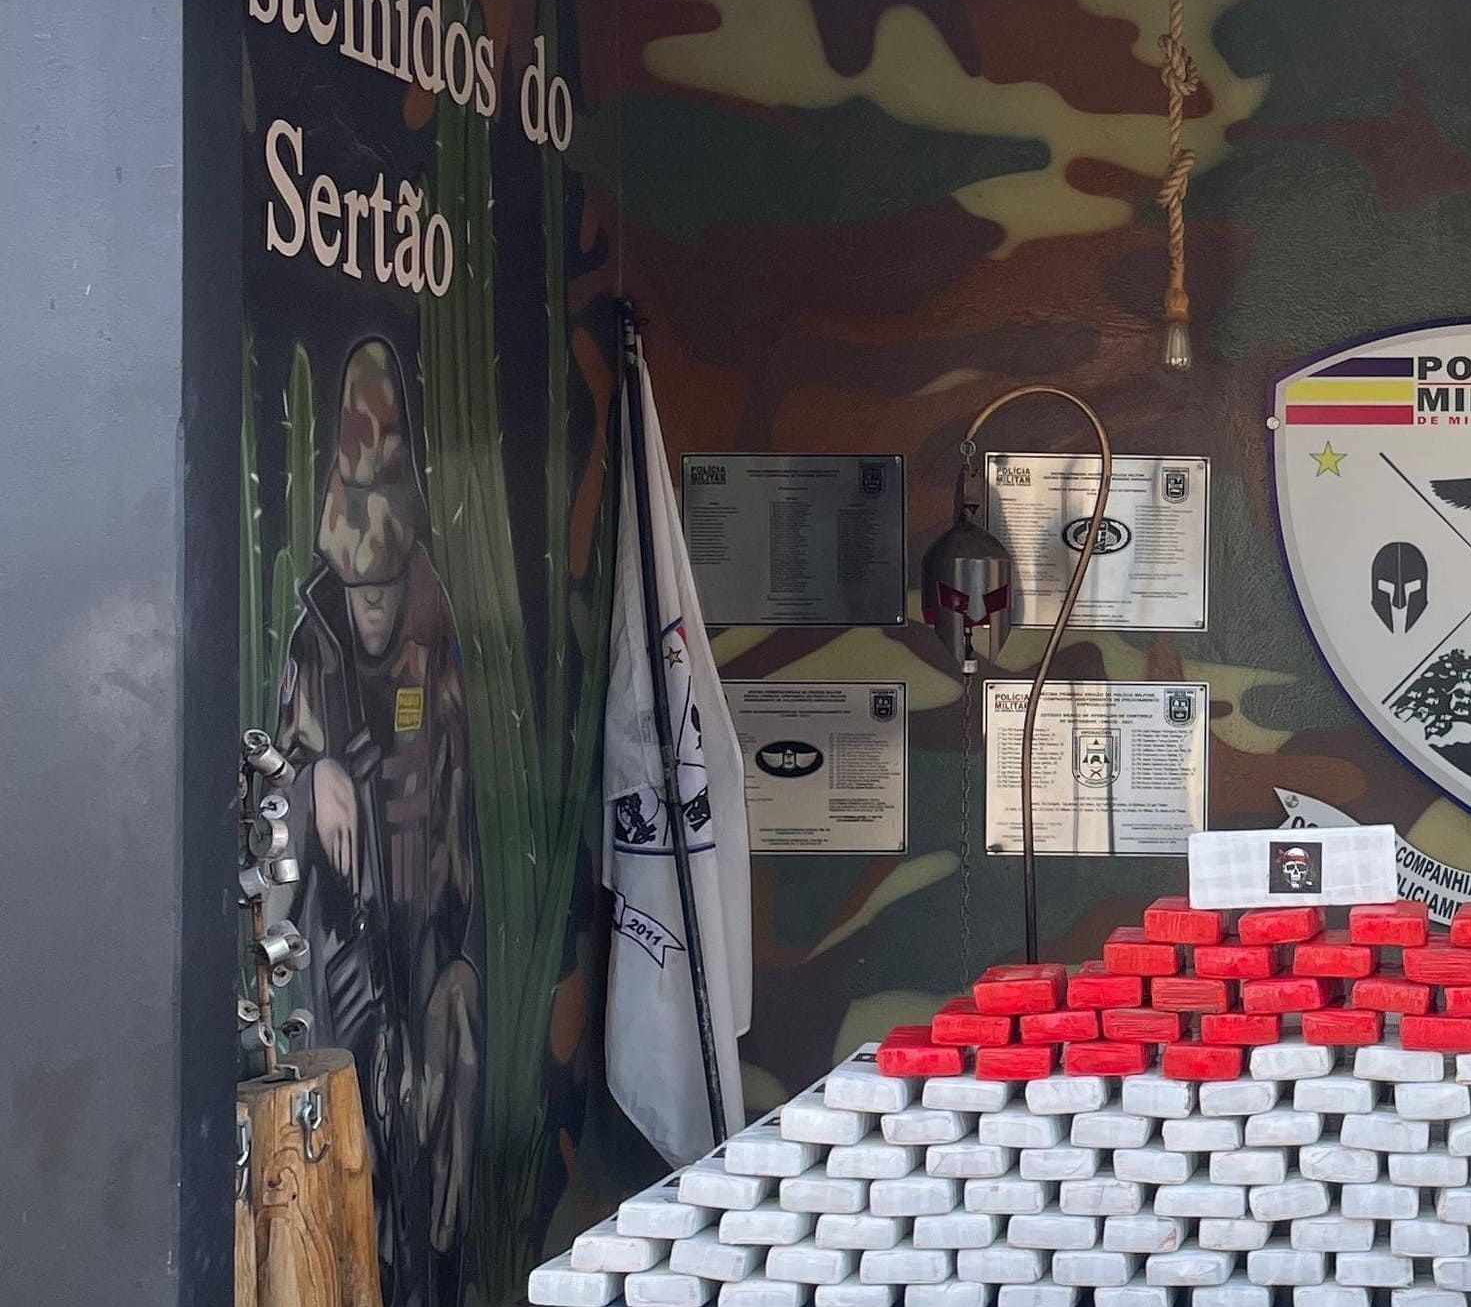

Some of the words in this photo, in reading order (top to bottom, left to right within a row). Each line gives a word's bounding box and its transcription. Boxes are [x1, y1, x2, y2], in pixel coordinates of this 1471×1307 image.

[520, 34, 573, 152] do
[265, 118, 454, 297] Sertão
[1417, 416, 1439, 425] DE
[626, 917, 664, 947] 2011
